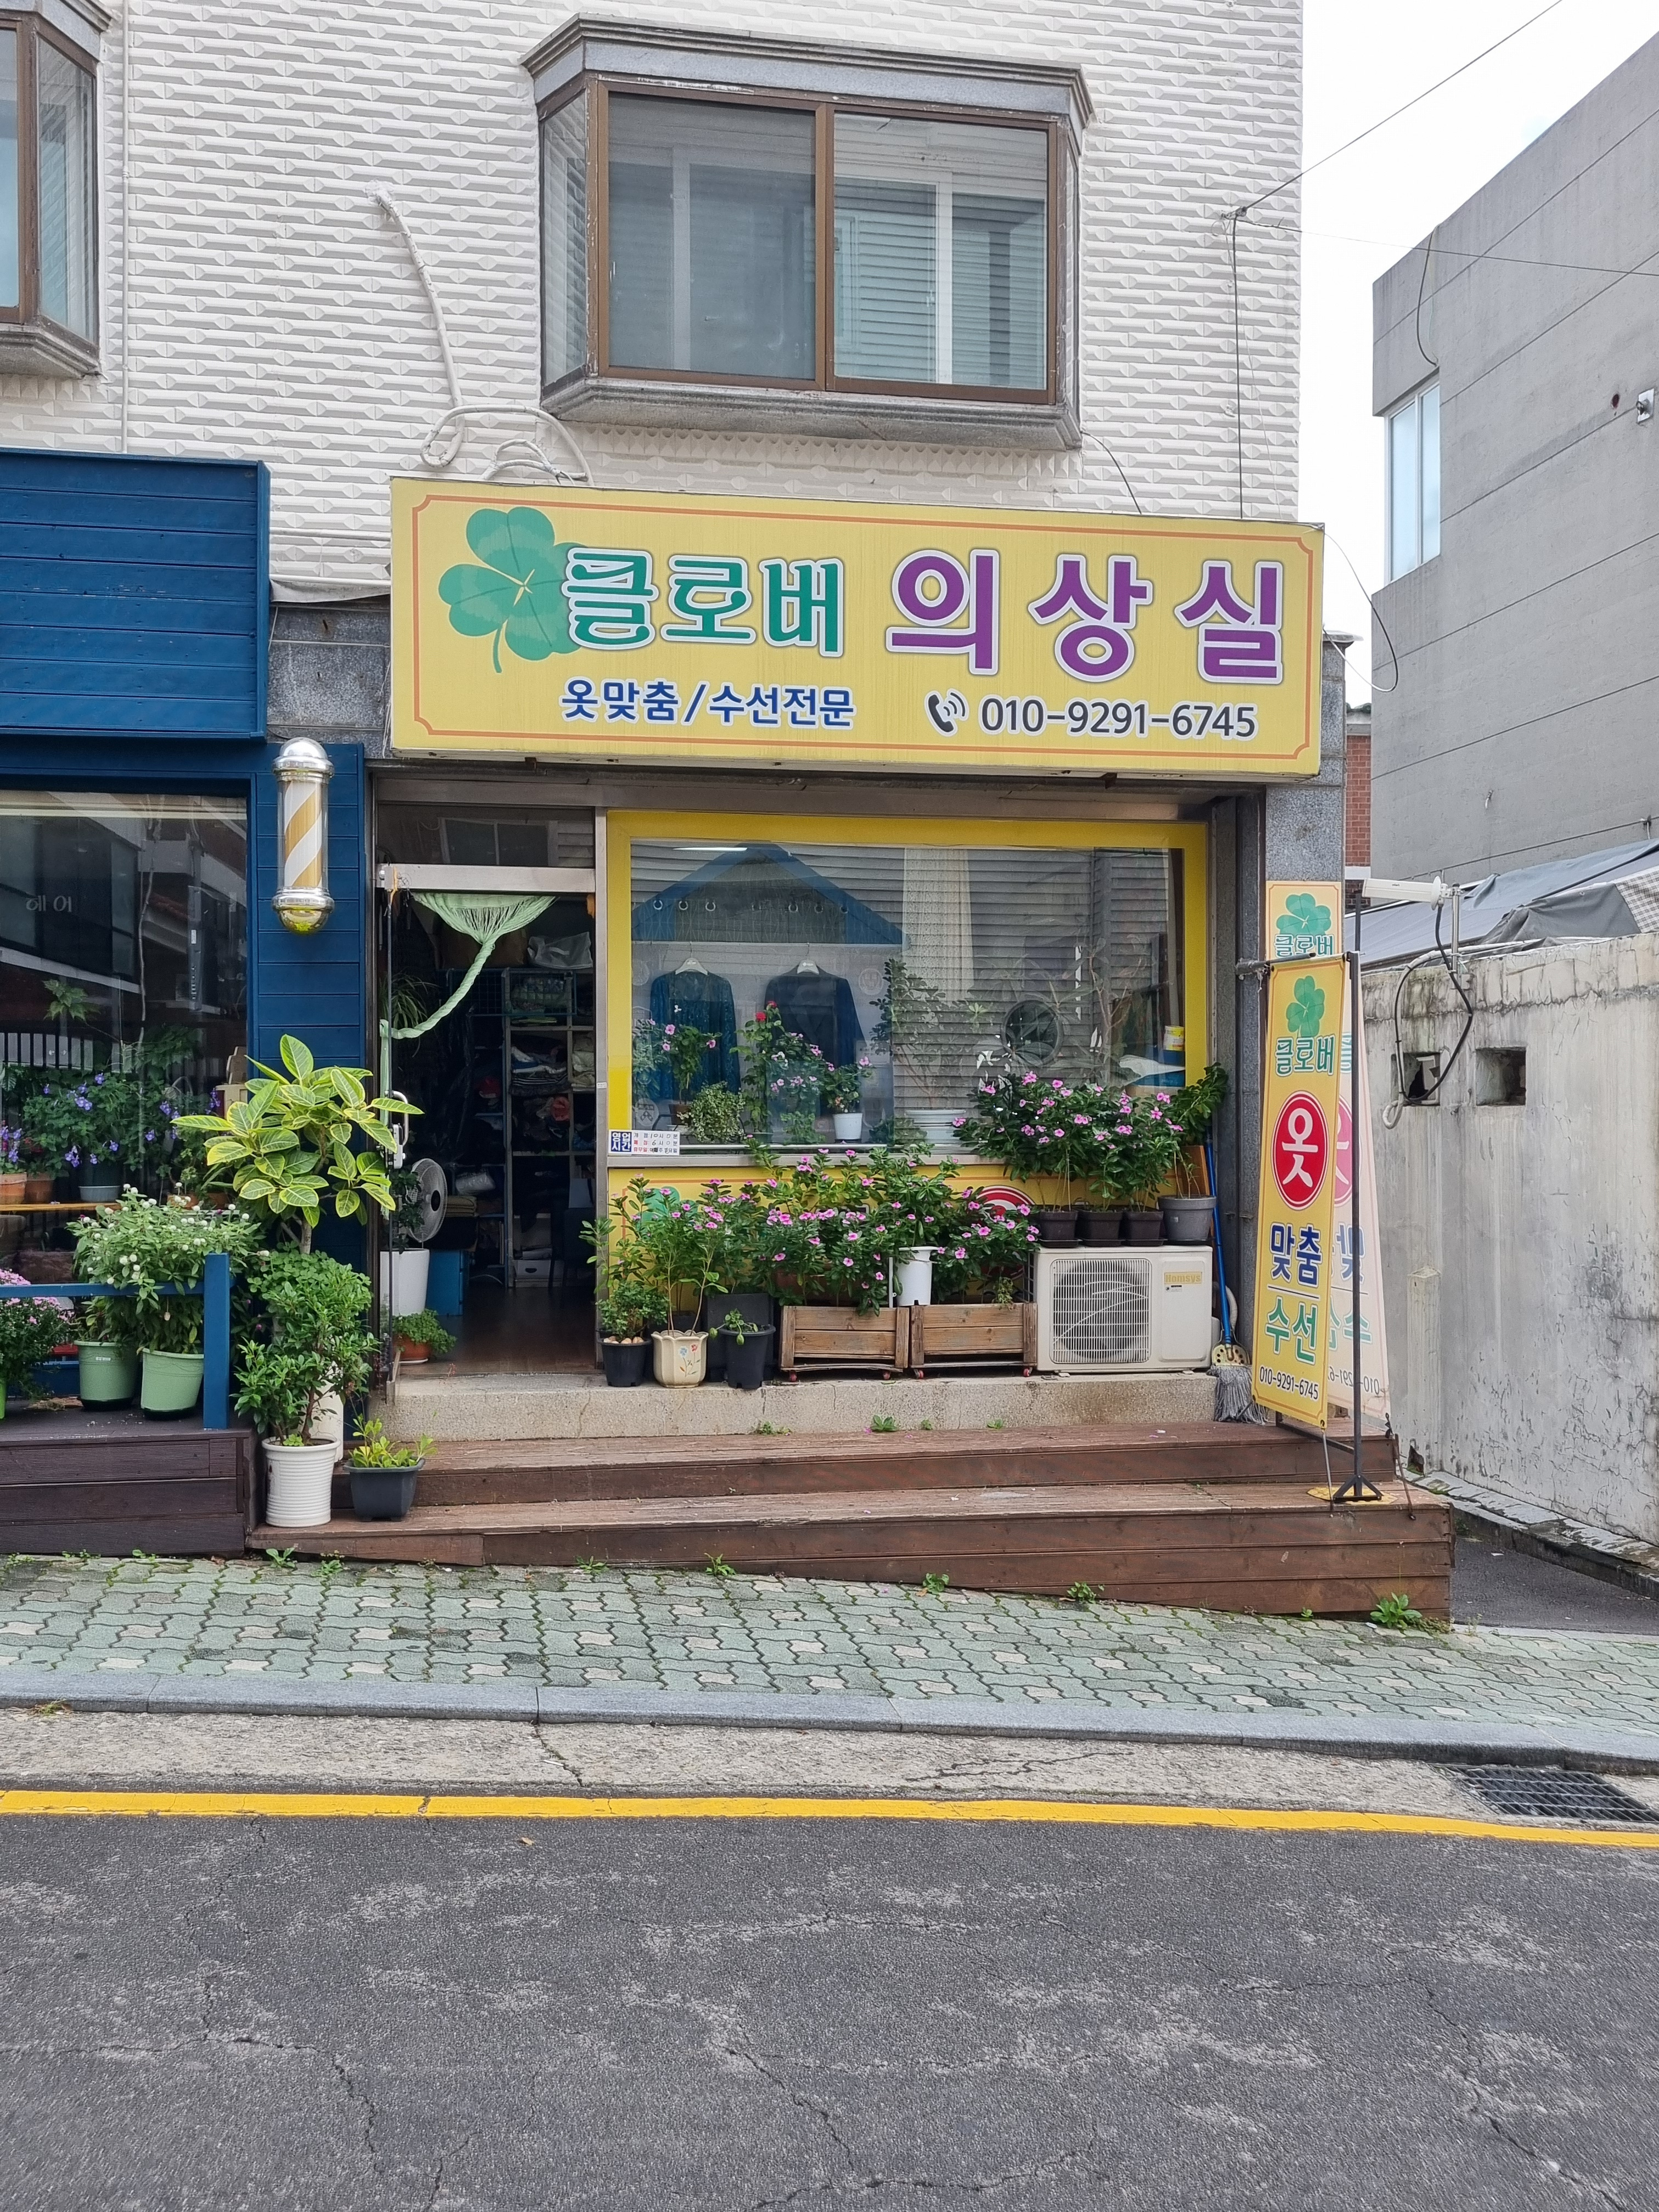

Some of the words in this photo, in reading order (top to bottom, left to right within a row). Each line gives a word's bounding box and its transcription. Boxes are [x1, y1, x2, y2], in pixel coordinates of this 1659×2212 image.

[563, 549, 842, 655] 클로버
[888, 551, 1282, 682] 의상실
[560, 678, 855, 728] 옷맞춤/수선전문
[980, 698, 1257, 737] 010-9291-6745
[1274, 935, 1334, 957] 클로버
[1276, 1035, 1335, 1076] 클로버
[612, 1132, 631, 1142] 영업
[612, 1141, 631, 1152] 시간
[1282, 1108, 1318, 1188] 옷
[1270, 1223, 1322, 1288] 맞춤
[1266, 1296, 1317, 1364] 수선
[1259, 1365, 1319, 1400] 010-9291-6745
